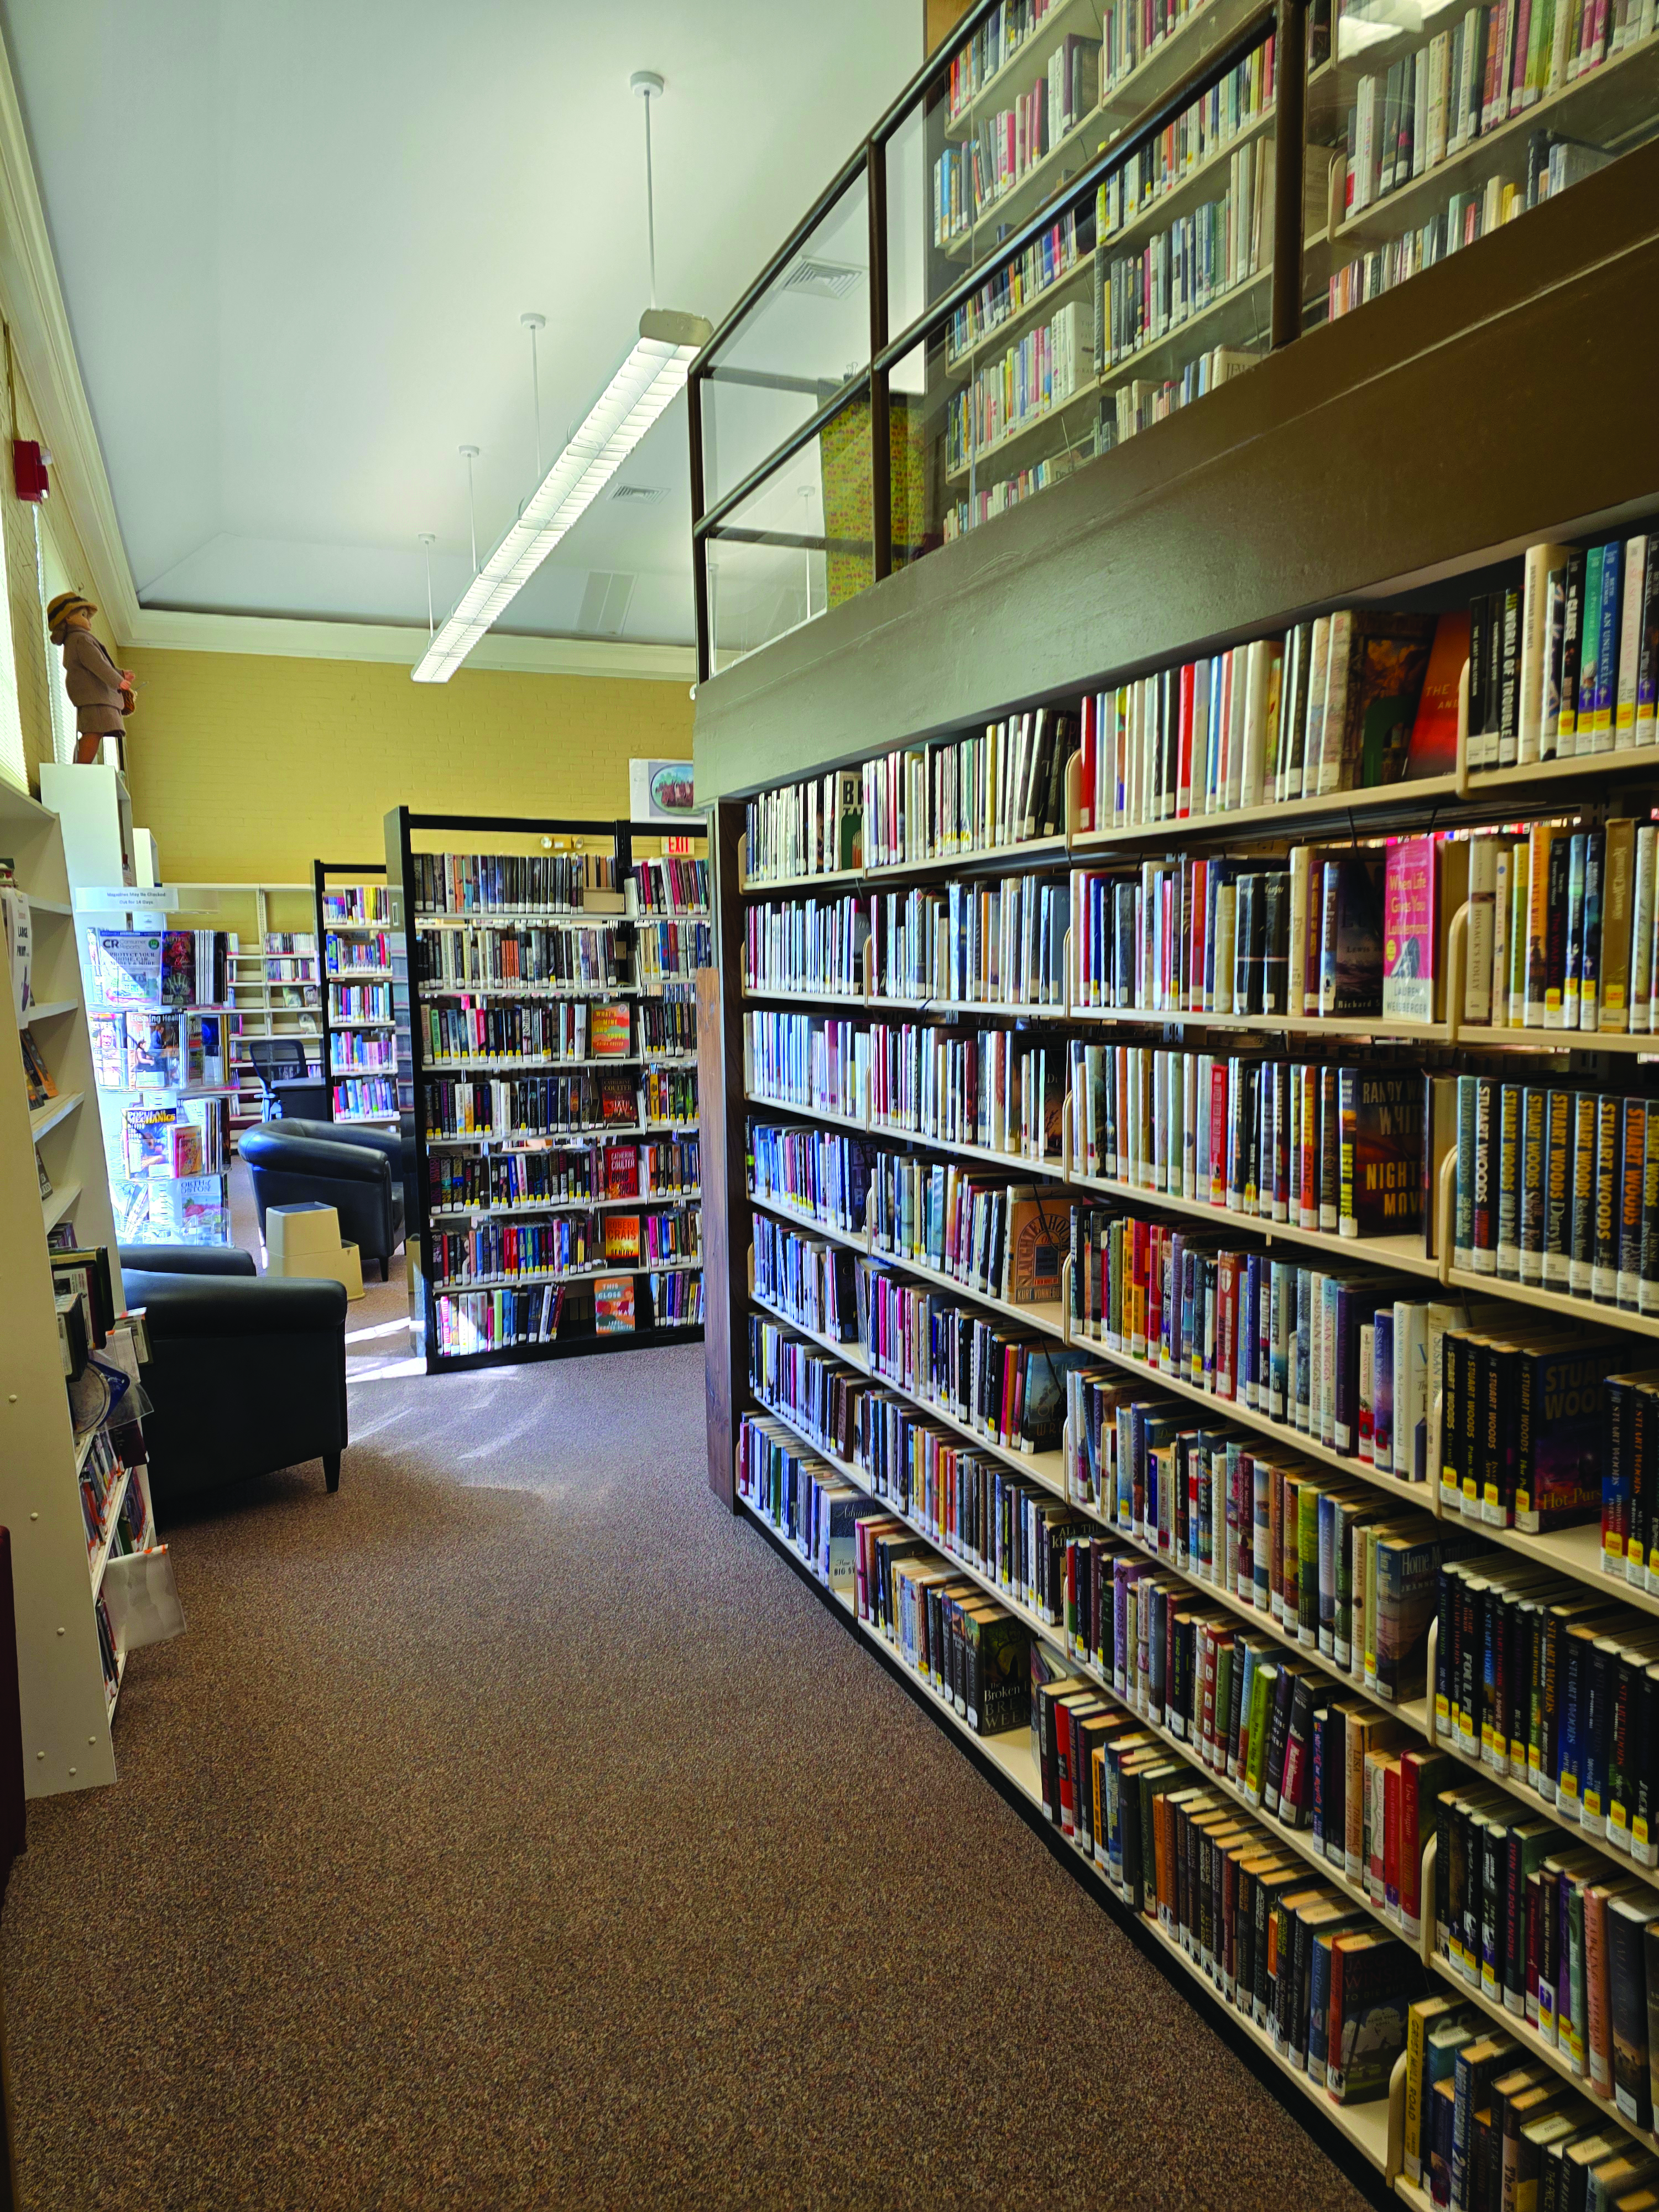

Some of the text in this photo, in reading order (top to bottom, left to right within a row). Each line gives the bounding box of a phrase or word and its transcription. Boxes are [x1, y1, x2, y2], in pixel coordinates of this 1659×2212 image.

[1601, 612, 1613, 685] AN UNLIKELY
[1501, 608, 1517, 739] WORLD OF TROUBLE
[1425, 685, 1451, 697] THE
[669, 837, 690, 853] EXIT
[1389, 871, 1427, 891] When Life
[1391, 896, 1426, 913] Gives You
[18, 926, 28, 938] LARGE
[103, 939, 119, 948] CR
[1551, 912, 1561, 962] The WAR
[17, 945, 26, 957] PRINT
[1470, 909, 1483, 990] HOSACK'S FOLLY
[1338, 999, 1371, 1009] Richard
[1386, 1001, 1428, 1014] WEISBERGER
[1394, 986, 1420, 997] LAUREN
[131, 1015, 161, 1024] Hearing
[1363, 1081, 1404, 1104] RANDY
[127, 1113, 176, 1124] MECHANICS
[1478, 1086, 1490, 1141] STUART
[1502, 1091, 1518, 1140] STUART
[1527, 1094, 1543, 1139] STUART
[1550, 1094, 1568, 1198] STUART WOODS
[1575, 1100, 1595, 1198] STUART WOODS
[1625, 1108, 1647, 1166] STUART
[611, 1150, 635, 1160] CATHERINE
[611, 1159, 635, 1171] COULTER
[1501, 1142, 1516, 1191] WOODS
[1526, 1142, 1541, 1188] WOODS
[612, 1171, 629, 1183] BOMB
[1302, 1151, 1314, 1193] GONE
[1366, 1162, 1418, 1190] NIGHT
[1475, 1143, 1489, 1204] WOODS
[1596, 1103, 1616, 1240] STUART WOODS
[618, 1182, 635, 1196] SHELL
[1623, 1169, 1643, 1225] WOODS
[608, 1220, 635, 1229] ROBERT
[608, 1228, 636, 1240] CRAIS
[1017, 1289, 1032, 1301] KURT
[1312, 1298, 1322, 1383] SUSAN WIGGS
[1323, 1303, 1333, 1383] SUSAN WIGGS
[1467, 1360, 1476, 1438] STUART WOODS
[1488, 1372, 1497, 1449] STUART WOODS
[1520, 1373, 1530, 1453] STUART WOODS
[1542, 1490, 1568, 1511] Hot
[1058, 1525, 1076, 1537] ALL
[1402, 1551, 1430, 1577] Home
[1401, 1580, 1435, 1593] JEANNE
[1117, 1596, 1125, 1667] CROSSTALK
[1496, 1620, 1504, 1652] STUART
[1546, 1619, 1557, 1667] STUART
[1484, 1612, 1493, 1685] STUART WOODS
[1463, 1651, 1473, 1693] FOUL
[984, 1684, 1020, 1702] Broken
[1545, 1668, 1556, 1715] WOODS
[1566, 1660, 1578, 1745] STUART WOODS
[1616, 1683, 1627, 1766] STUART WOODS
[1406, 1783, 1414, 1801] Lisa
[1165, 1804, 1173, 1870] JACQUELINE
[1405, 1805, 1414, 1839] Wingate
[1508, 1842, 1517, 1869] EVEN
[1507, 1893, 1516, 1918] DOG
[1507, 1919, 1515, 1960] KNOWS
[1316, 1945, 1324, 1973] GOOD
[1345, 1992, 1358, 2001] TO
[1408, 2018, 1420, 2121] GRIST MILL ROAD
[1546, 2169, 1555, 2185] THE
